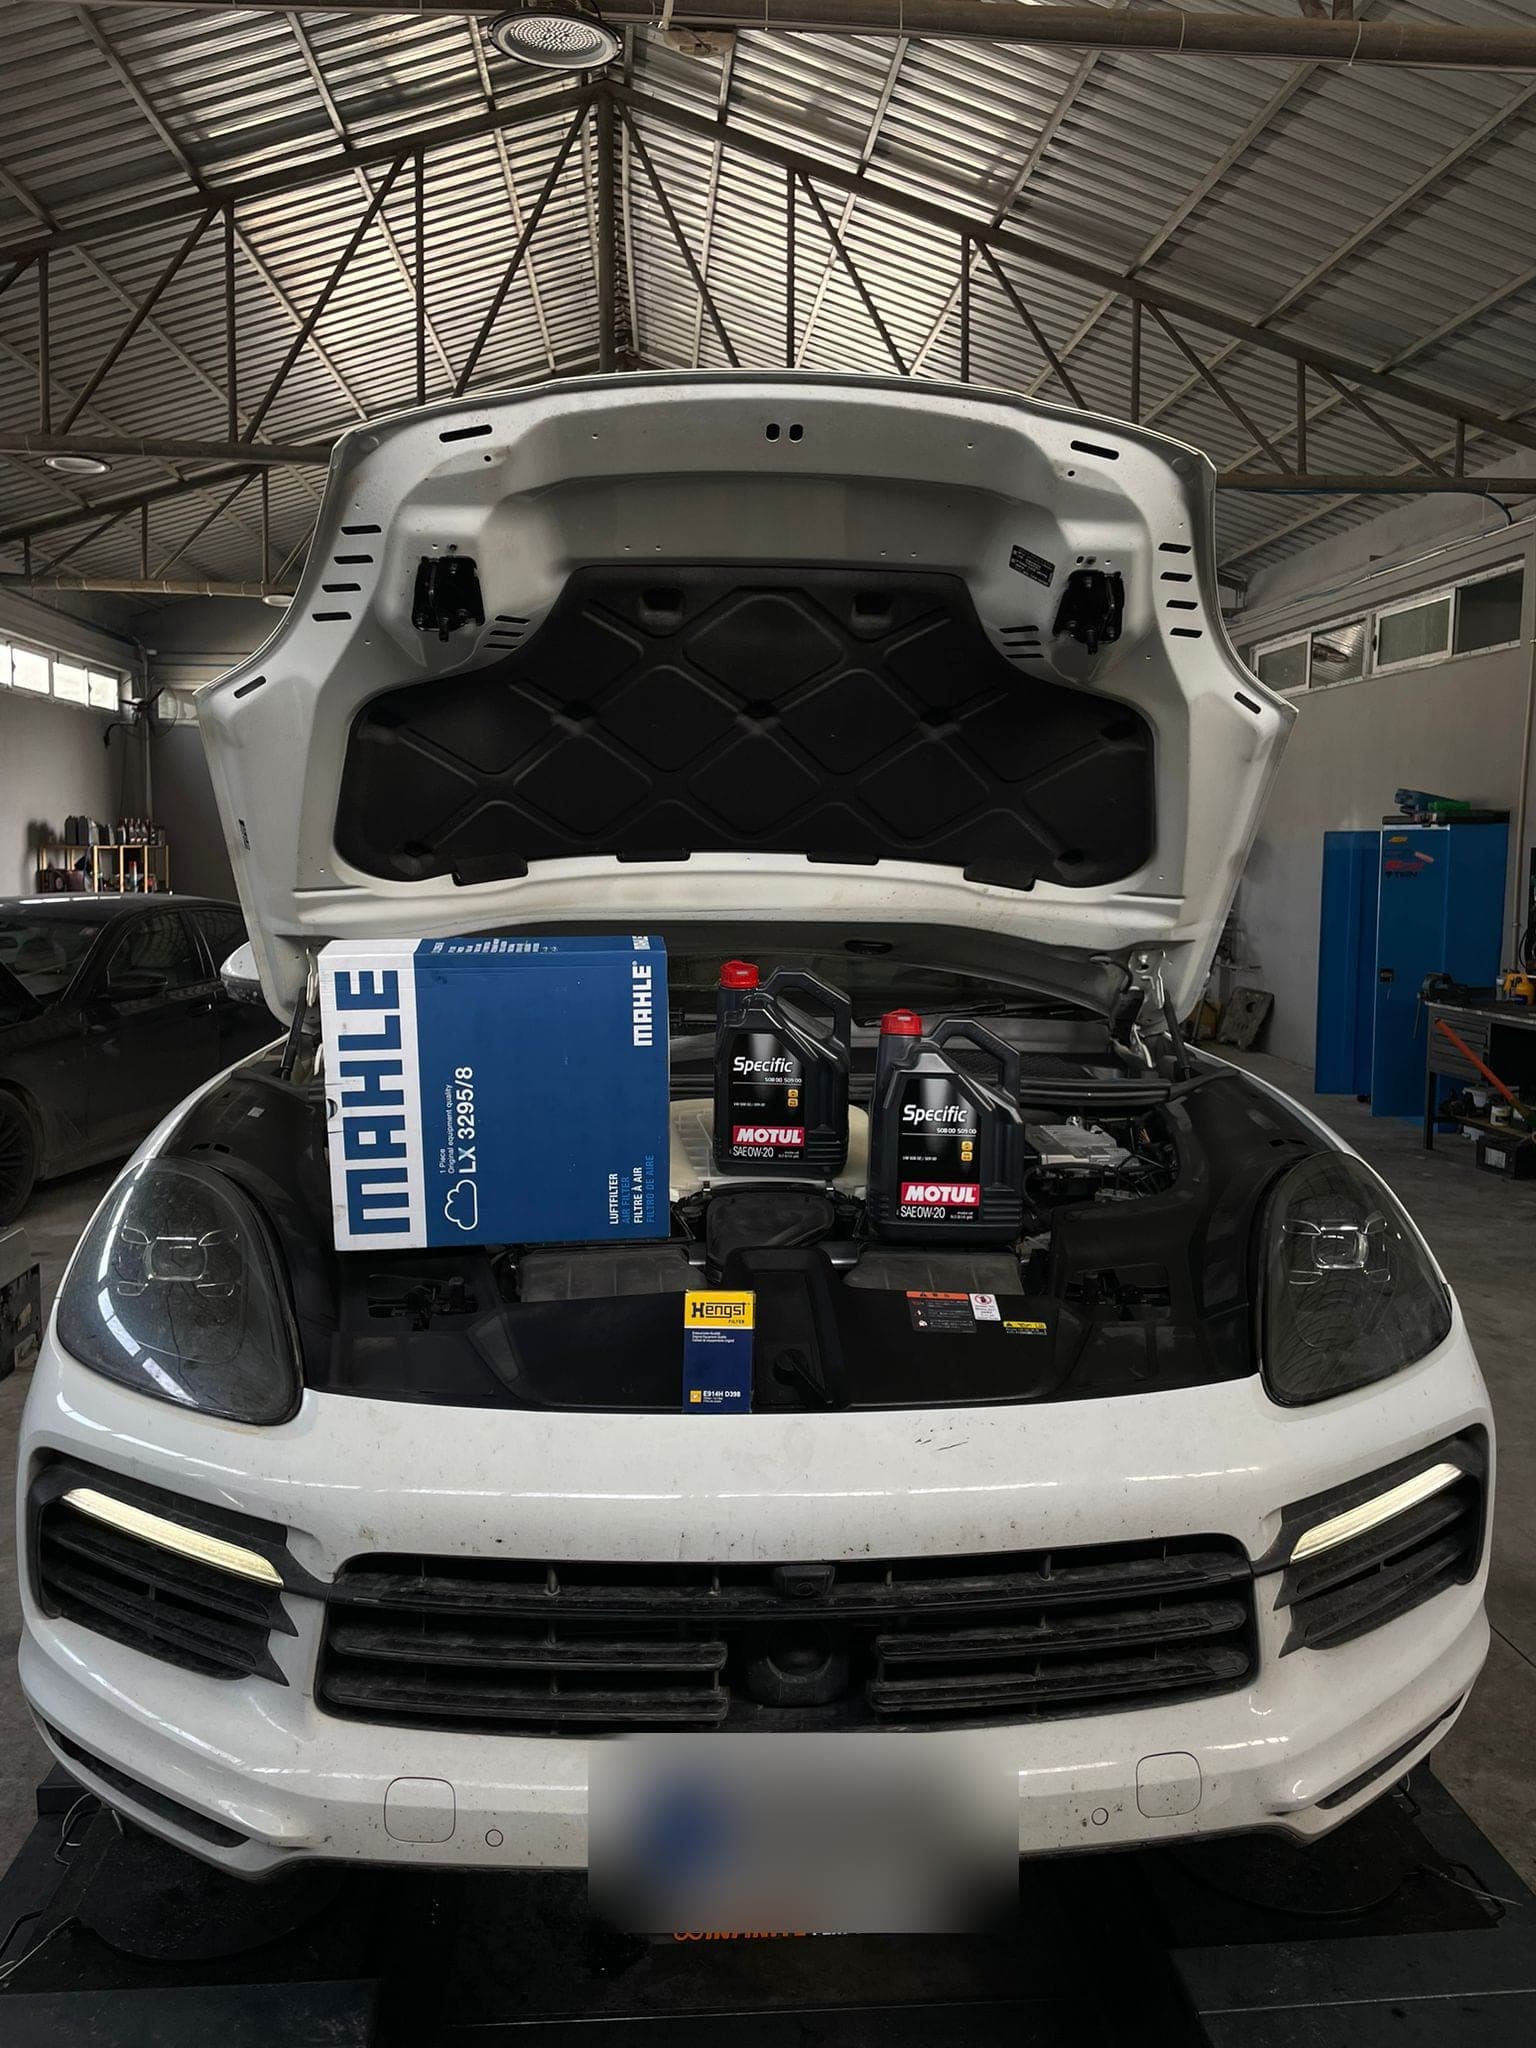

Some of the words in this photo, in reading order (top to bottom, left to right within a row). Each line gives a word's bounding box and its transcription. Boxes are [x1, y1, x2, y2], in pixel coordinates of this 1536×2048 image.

[632, 965, 653, 1046] MAHLE
[732, 1056, 794, 1075] Specific
[334, 970, 411, 1235] MAHLE
[444, 1084, 453, 1108] quality
[454, 1066, 475, 1139] 3295/8
[902, 1104, 968, 1126] Specific
[446, 1109, 454, 1146] equipment
[736, 1128, 802, 1144] MOTUL
[447, 1147, 456, 1174] Original
[458, 1146, 477, 1173] LX
[732, 1145, 747, 1157] SAE
[747, 1147, 774, 1158] 0W-20
[633, 1167, 643, 1183] AIR
[645, 1153, 655, 1176] AIRE
[621, 1176, 630, 1207] FILTER
[645, 1178, 655, 1190] DE
[905, 1185, 976, 1203] MOTUL
[608, 1173, 619, 1225] LUFTFILTER
[633, 1194, 643, 1224] FILTRE
[645, 1193, 655, 1223] FILTRO
[621, 1208, 630, 1224] AIR
[900, 1205, 917, 1218] SAE
[917, 1206, 946, 1219] 0W-20
[691, 1302, 746, 1318] Hengst
